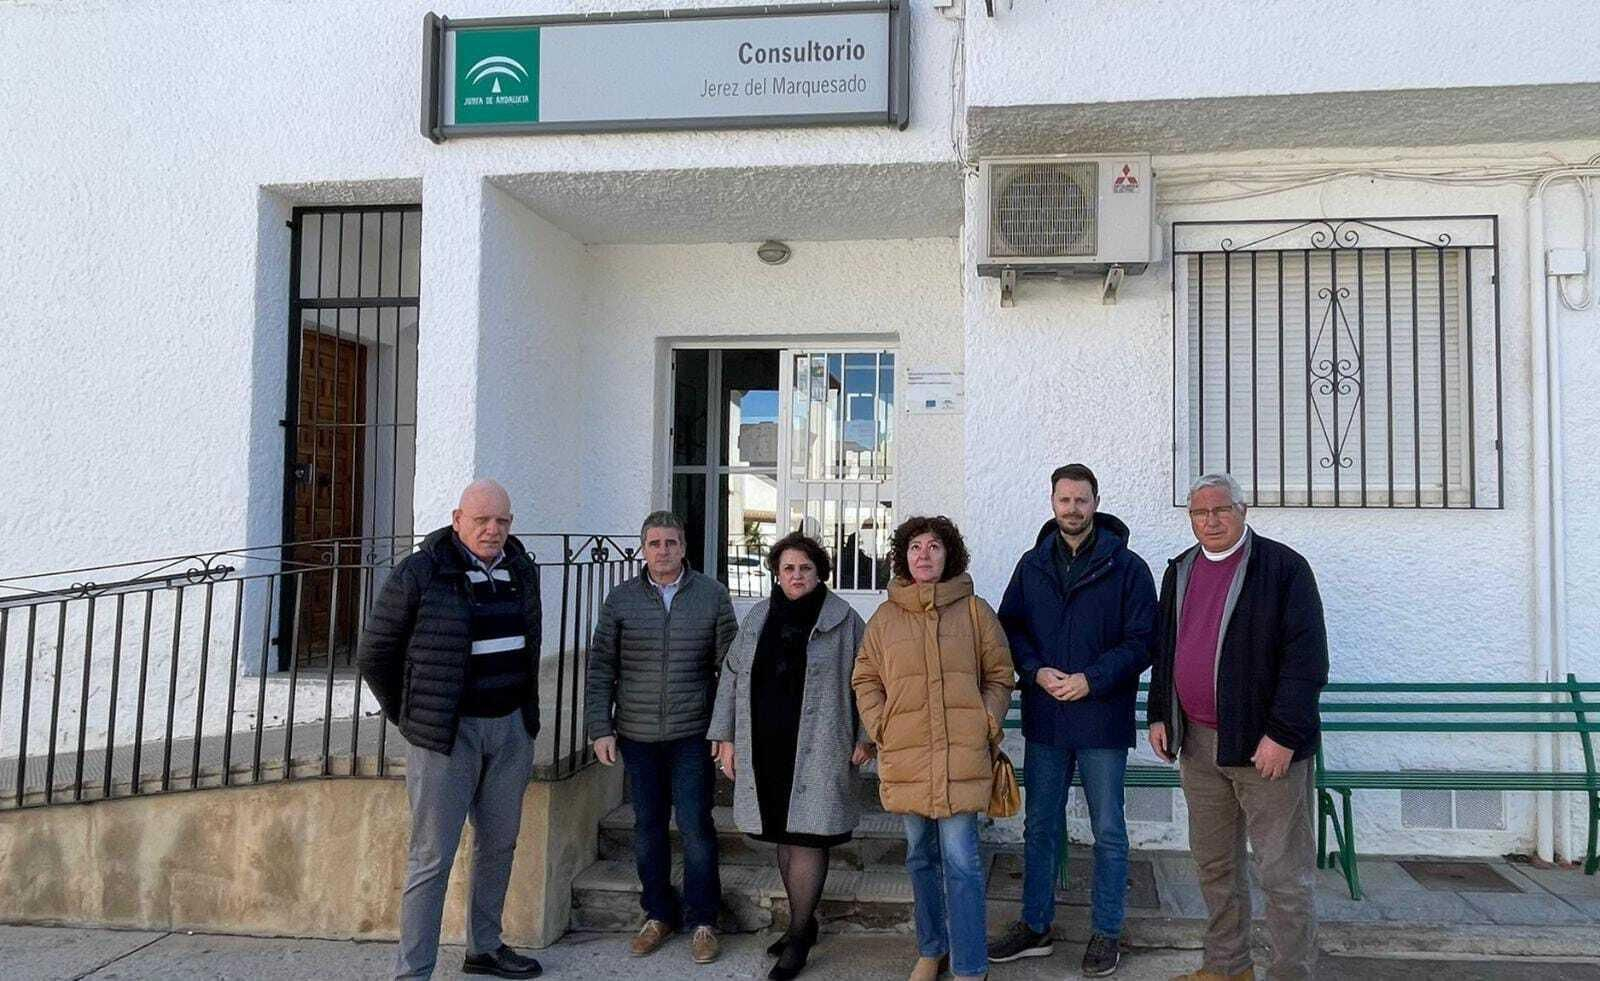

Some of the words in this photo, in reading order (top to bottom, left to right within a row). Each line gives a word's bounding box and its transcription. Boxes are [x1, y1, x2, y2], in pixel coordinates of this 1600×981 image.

[738, 38, 866, 64] Consultorio
[700, 79, 739, 98] Jerez
[744, 77, 767, 96] del
[772, 74, 867, 98] Marquesado
[485, 96, 493, 105] DE
